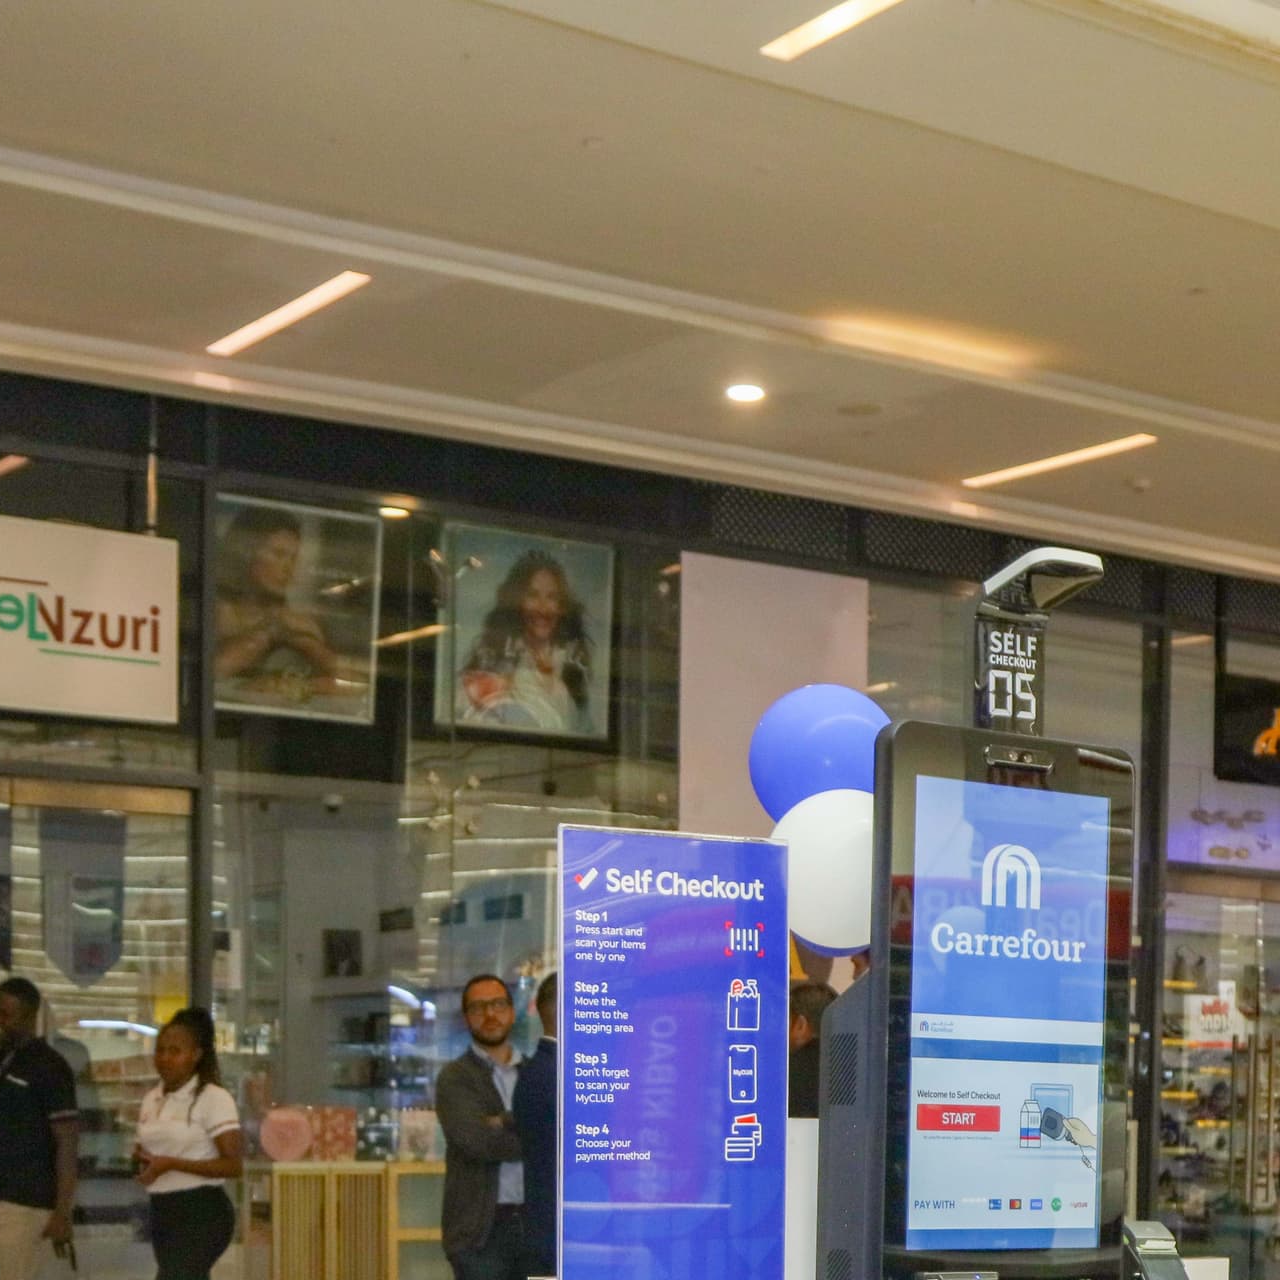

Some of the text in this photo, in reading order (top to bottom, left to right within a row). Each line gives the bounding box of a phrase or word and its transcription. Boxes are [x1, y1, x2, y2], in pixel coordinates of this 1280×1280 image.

[990, 631, 1037, 657] SELF
[990, 655, 1036, 670] CHECKOUT
[989, 670, 1036, 720] 05
[606, 868, 764, 901] Self Checkout
[575, 910, 607, 922] Step 1
[576, 925, 642, 936] Press start and
[576, 939, 646, 951] scan your items
[931, 923, 1086, 963] Carrefour
[576, 951, 625, 963] one by one
[575, 982, 608, 994] Step 2
[575, 997, 616, 1006] Move the
[574, 1010, 628, 1020] items to the
[574, 1022, 634, 1034] bagging area
[575, 1053, 607, 1065] Step 3
[576, 1067, 629, 1079] Don't forget
[576, 1081, 585, 1089] to
[611, 1082, 630, 1092] your
[576, 1094, 614, 1104] MyCLUB
[917, 1090, 1000, 1100] Welcome to Self Checkout
[942, 1113, 975, 1126] START
[576, 1124, 609, 1137] Step 4
[576, 1138, 631, 1150] Choose your
[576, 1151, 650, 1163] payment method
[914, 1200, 955, 1209] PAY WITH
